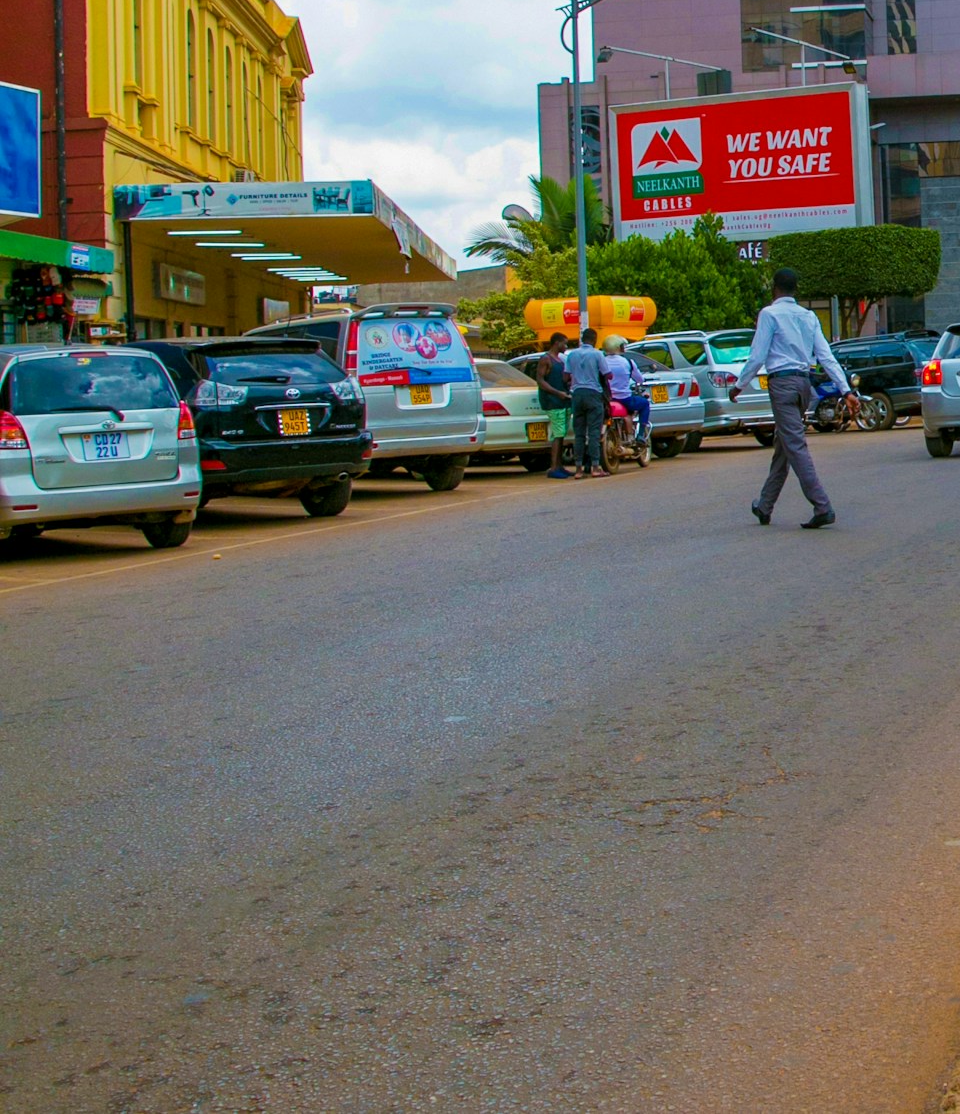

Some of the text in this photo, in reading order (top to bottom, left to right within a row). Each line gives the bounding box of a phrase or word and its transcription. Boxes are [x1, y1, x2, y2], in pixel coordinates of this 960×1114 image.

[726, 126, 833, 154] WE WANT
[728, 152, 832, 179] YOU SAFE
[637, 175, 700, 194] NEELKANTH
[643, 196, 693, 212] CABLES
[732, 209, 849, 222] sales.ug@neelkanthcables.com
[362, 357, 404, 365] KINDERGARTEN
[288, 411, 305, 421] UAZ
[284, 421, 306, 432] 945T
[95, 433, 122, 446] CD 27
[96, 446, 118, 458] 22 U
